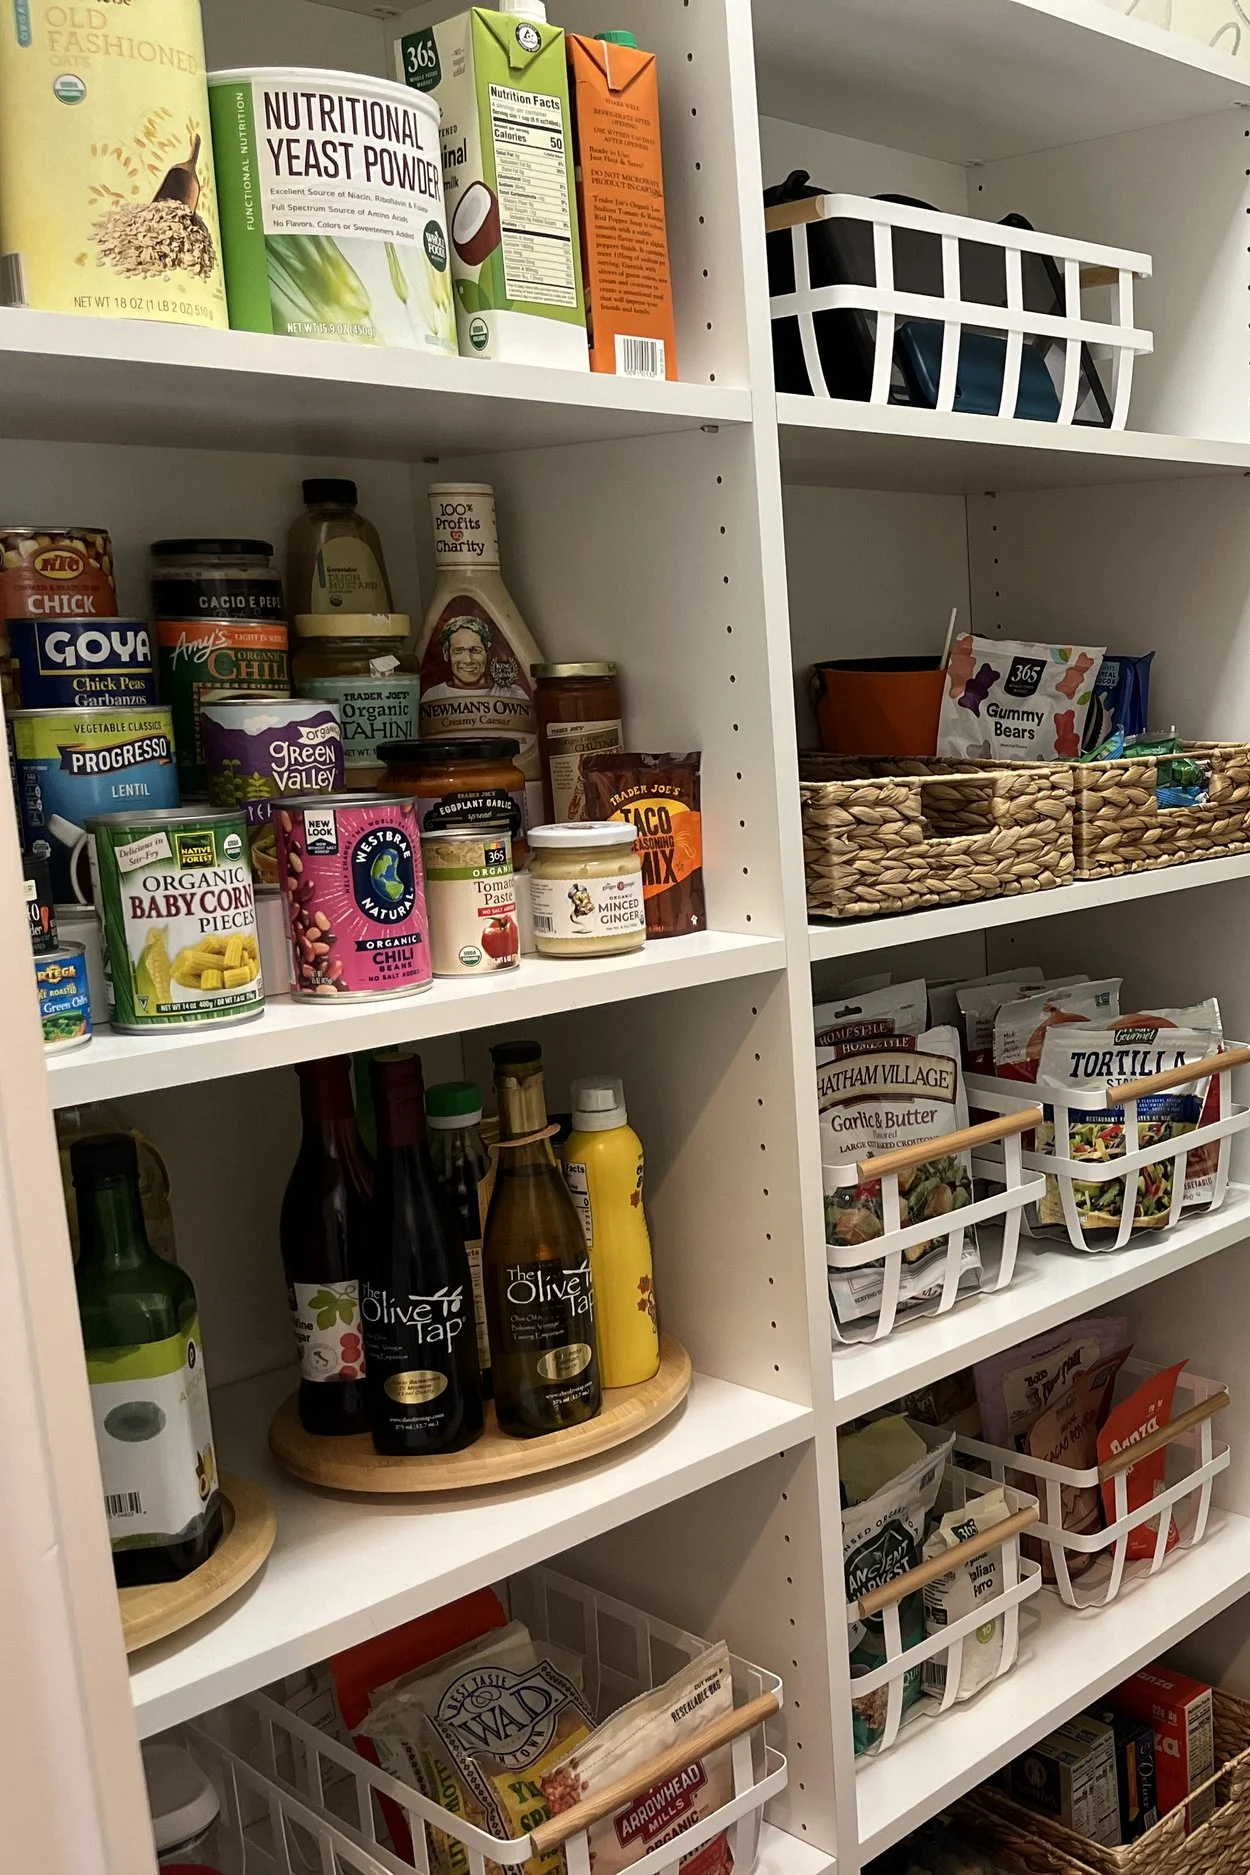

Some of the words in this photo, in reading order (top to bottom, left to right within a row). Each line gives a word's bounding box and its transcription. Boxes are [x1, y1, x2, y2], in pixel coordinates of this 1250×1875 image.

[46, 6, 107, 30] OLD
[48, 30, 199, 75] FASHIONED
[407, 41, 436, 73] 365
[491, 86, 531, 105] Nutrition
[533, 95, 561, 110] Facts
[236, 91, 250, 156] NUTRITION
[263, 91, 425, 151] NUTRITIONAL
[494, 129, 527, 144] Calories
[550, 137, 563, 150] 50
[266, 138, 355, 181] YEAST
[363, 144, 442, 202] POWDER
[241, 157, 256, 232] FUNCTIONAL
[271, 203, 286, 212] Full
[287, 323, 302, 334] NET
[440, 503, 474, 517] 100%
[436, 517, 481, 531] Profits
[436, 540, 486, 556] Charity
[27, 595, 96, 614] CHICK
[199, 596, 246, 608] CACIO
[44, 631, 152, 667] GOYA
[169, 628, 229, 672] Amy's
[73, 677, 117, 691] Chick
[120, 676, 146, 690] Peas
[1011, 663, 1042, 684] 365
[343, 692, 384, 702] TRADER
[493, 699, 531, 717] OWN
[342, 702, 410, 723] Organic
[986, 702, 1046, 727] Gummy
[74, 721, 126, 734] VEGETABLE
[127, 720, 162, 733] CLASSICS
[340, 720, 413, 742] TAHINI
[994, 721, 1036, 741] Bears
[71, 737, 168, 774] PROGRESSO
[111, 782, 151, 798] LENTIL
[610, 784, 648, 806] TRADER
[307, 827, 334, 837] LOOK
[308, 820, 331, 829] NEW
[620, 806, 674, 837] TACO
[181, 846, 212, 856] NATIVE
[355, 830, 412, 864] WESTBRAE
[488, 848, 505, 863] 365
[182, 854, 214, 864] FOREST
[142, 867, 245, 893] ORGANIC
[129, 891, 198, 920] BABY
[199, 883, 253, 915] CORN
[361, 893, 415, 921] NATURAL
[484, 891, 513, 906] Paste
[598, 899, 640, 914] MINCED
[198, 910, 256, 934] PIECES
[600, 911, 640, 926] GINGER
[366, 935, 418, 950] ORGANIC
[372, 948, 415, 966] CHILI
[379, 962, 413, 973] BEANS
[43, 1001, 72, 1014] Green
[1114, 1029, 1156, 1043] Gourmet
[1069, 1050, 1187, 1079] TORTILLA
[882, 1064, 951, 1090] VILLAGE
[831, 1108, 874, 1132] Garlic
[873, 1110, 883, 1129] &
[884, 1107, 938, 1130] Butter
[839, 1140, 867, 1154] LARGE
[506, 1265, 535, 1281] The
[361, 1281, 381, 1299] The
[506, 1269, 581, 1304] Olive
[361, 1290, 433, 1324] Olive
[406, 1316, 464, 1354] Tap
[957, 1519, 979, 1542] 365
[849, 1540, 909, 1595] ANCIENT
[982, 1625, 992, 1636] 10
[446, 1684, 469, 1711] BEST
[470, 1673, 508, 1692] TASTE
[694, 1682, 706, 1691] CUT
[671, 1691, 708, 1723] RESEALABLE
[707, 1679, 722, 1698] BAG
[458, 1684, 552, 1748] WAD
[511, 1728, 545, 1769] TOWN
[621, 1761, 701, 1840] ARROWHEAD
[649, 1799, 685, 1833] MILLS
[645, 1810, 700, 1857] ORGANIC
